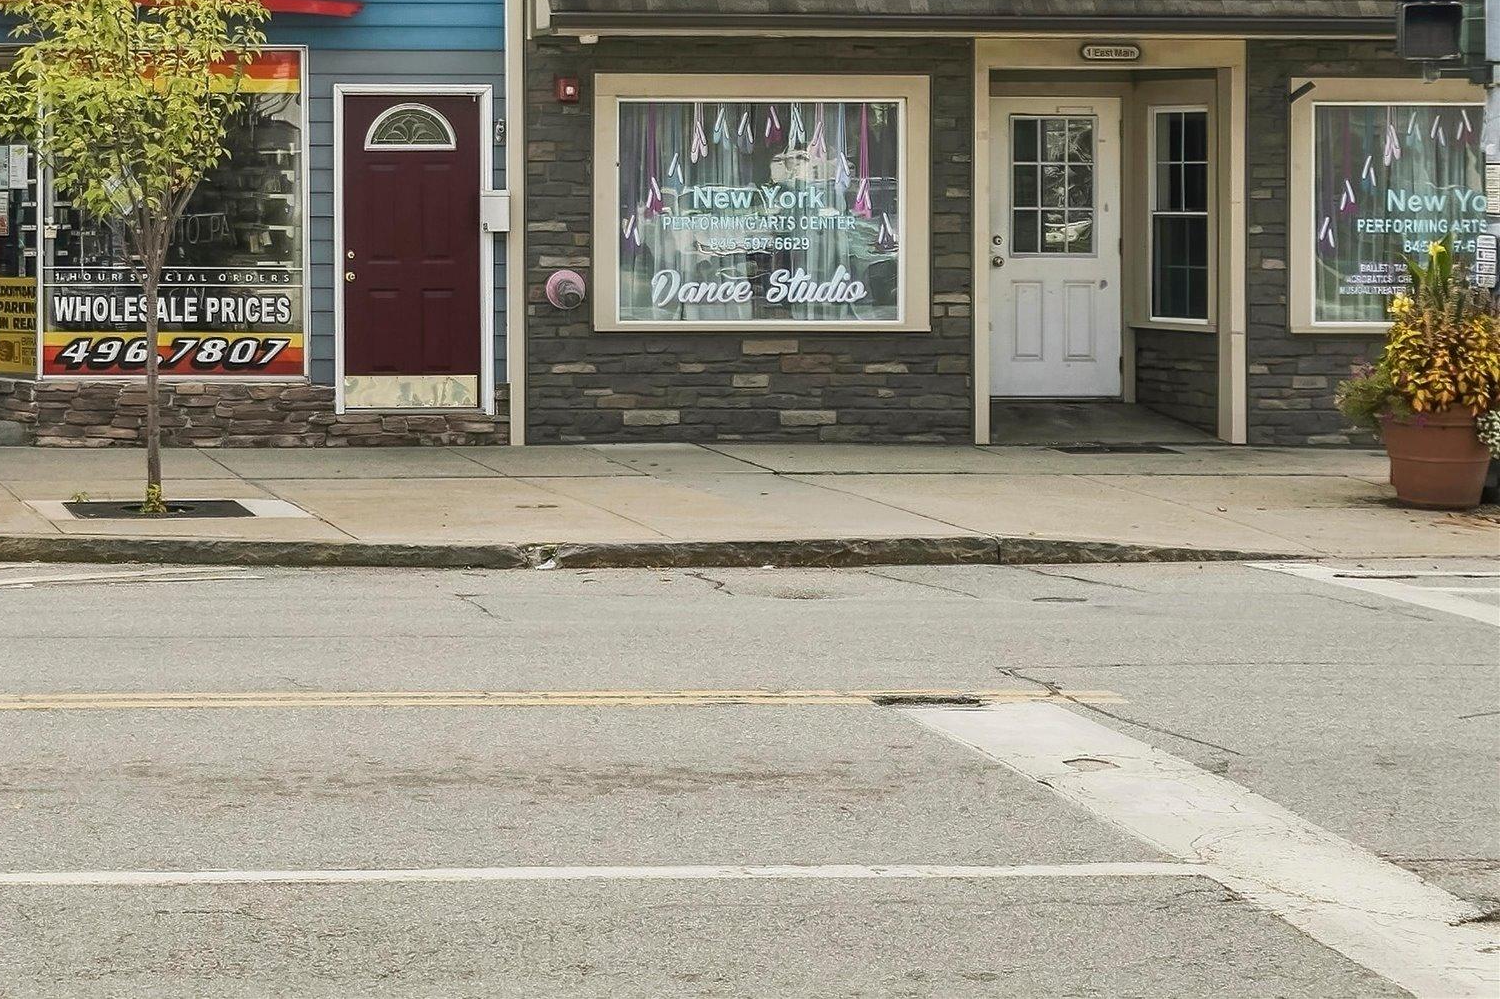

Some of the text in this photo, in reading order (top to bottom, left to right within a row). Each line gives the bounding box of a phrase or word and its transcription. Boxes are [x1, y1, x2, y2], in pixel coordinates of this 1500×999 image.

[693, 185, 825, 210] New York
[1387, 189, 1446, 212] New
[1454, 189, 1487, 212] Yo
[663, 216, 856, 231] PERFORMING ARTS CENTER
[1357, 219, 1487, 233] PERFORMING ARTS
[710, 238, 810, 251] 845-597-6629
[1360, 263, 1388, 272] BALLET
[70, 273, 120, 282] HOUR
[130, 273, 207, 282] SPCIAL
[219, 273, 290, 282] ORDERS
[1347, 275, 1393, 283] ACROBATICS
[651, 264, 868, 307] Dance Studio
[206, 297, 291, 323] PRICES
